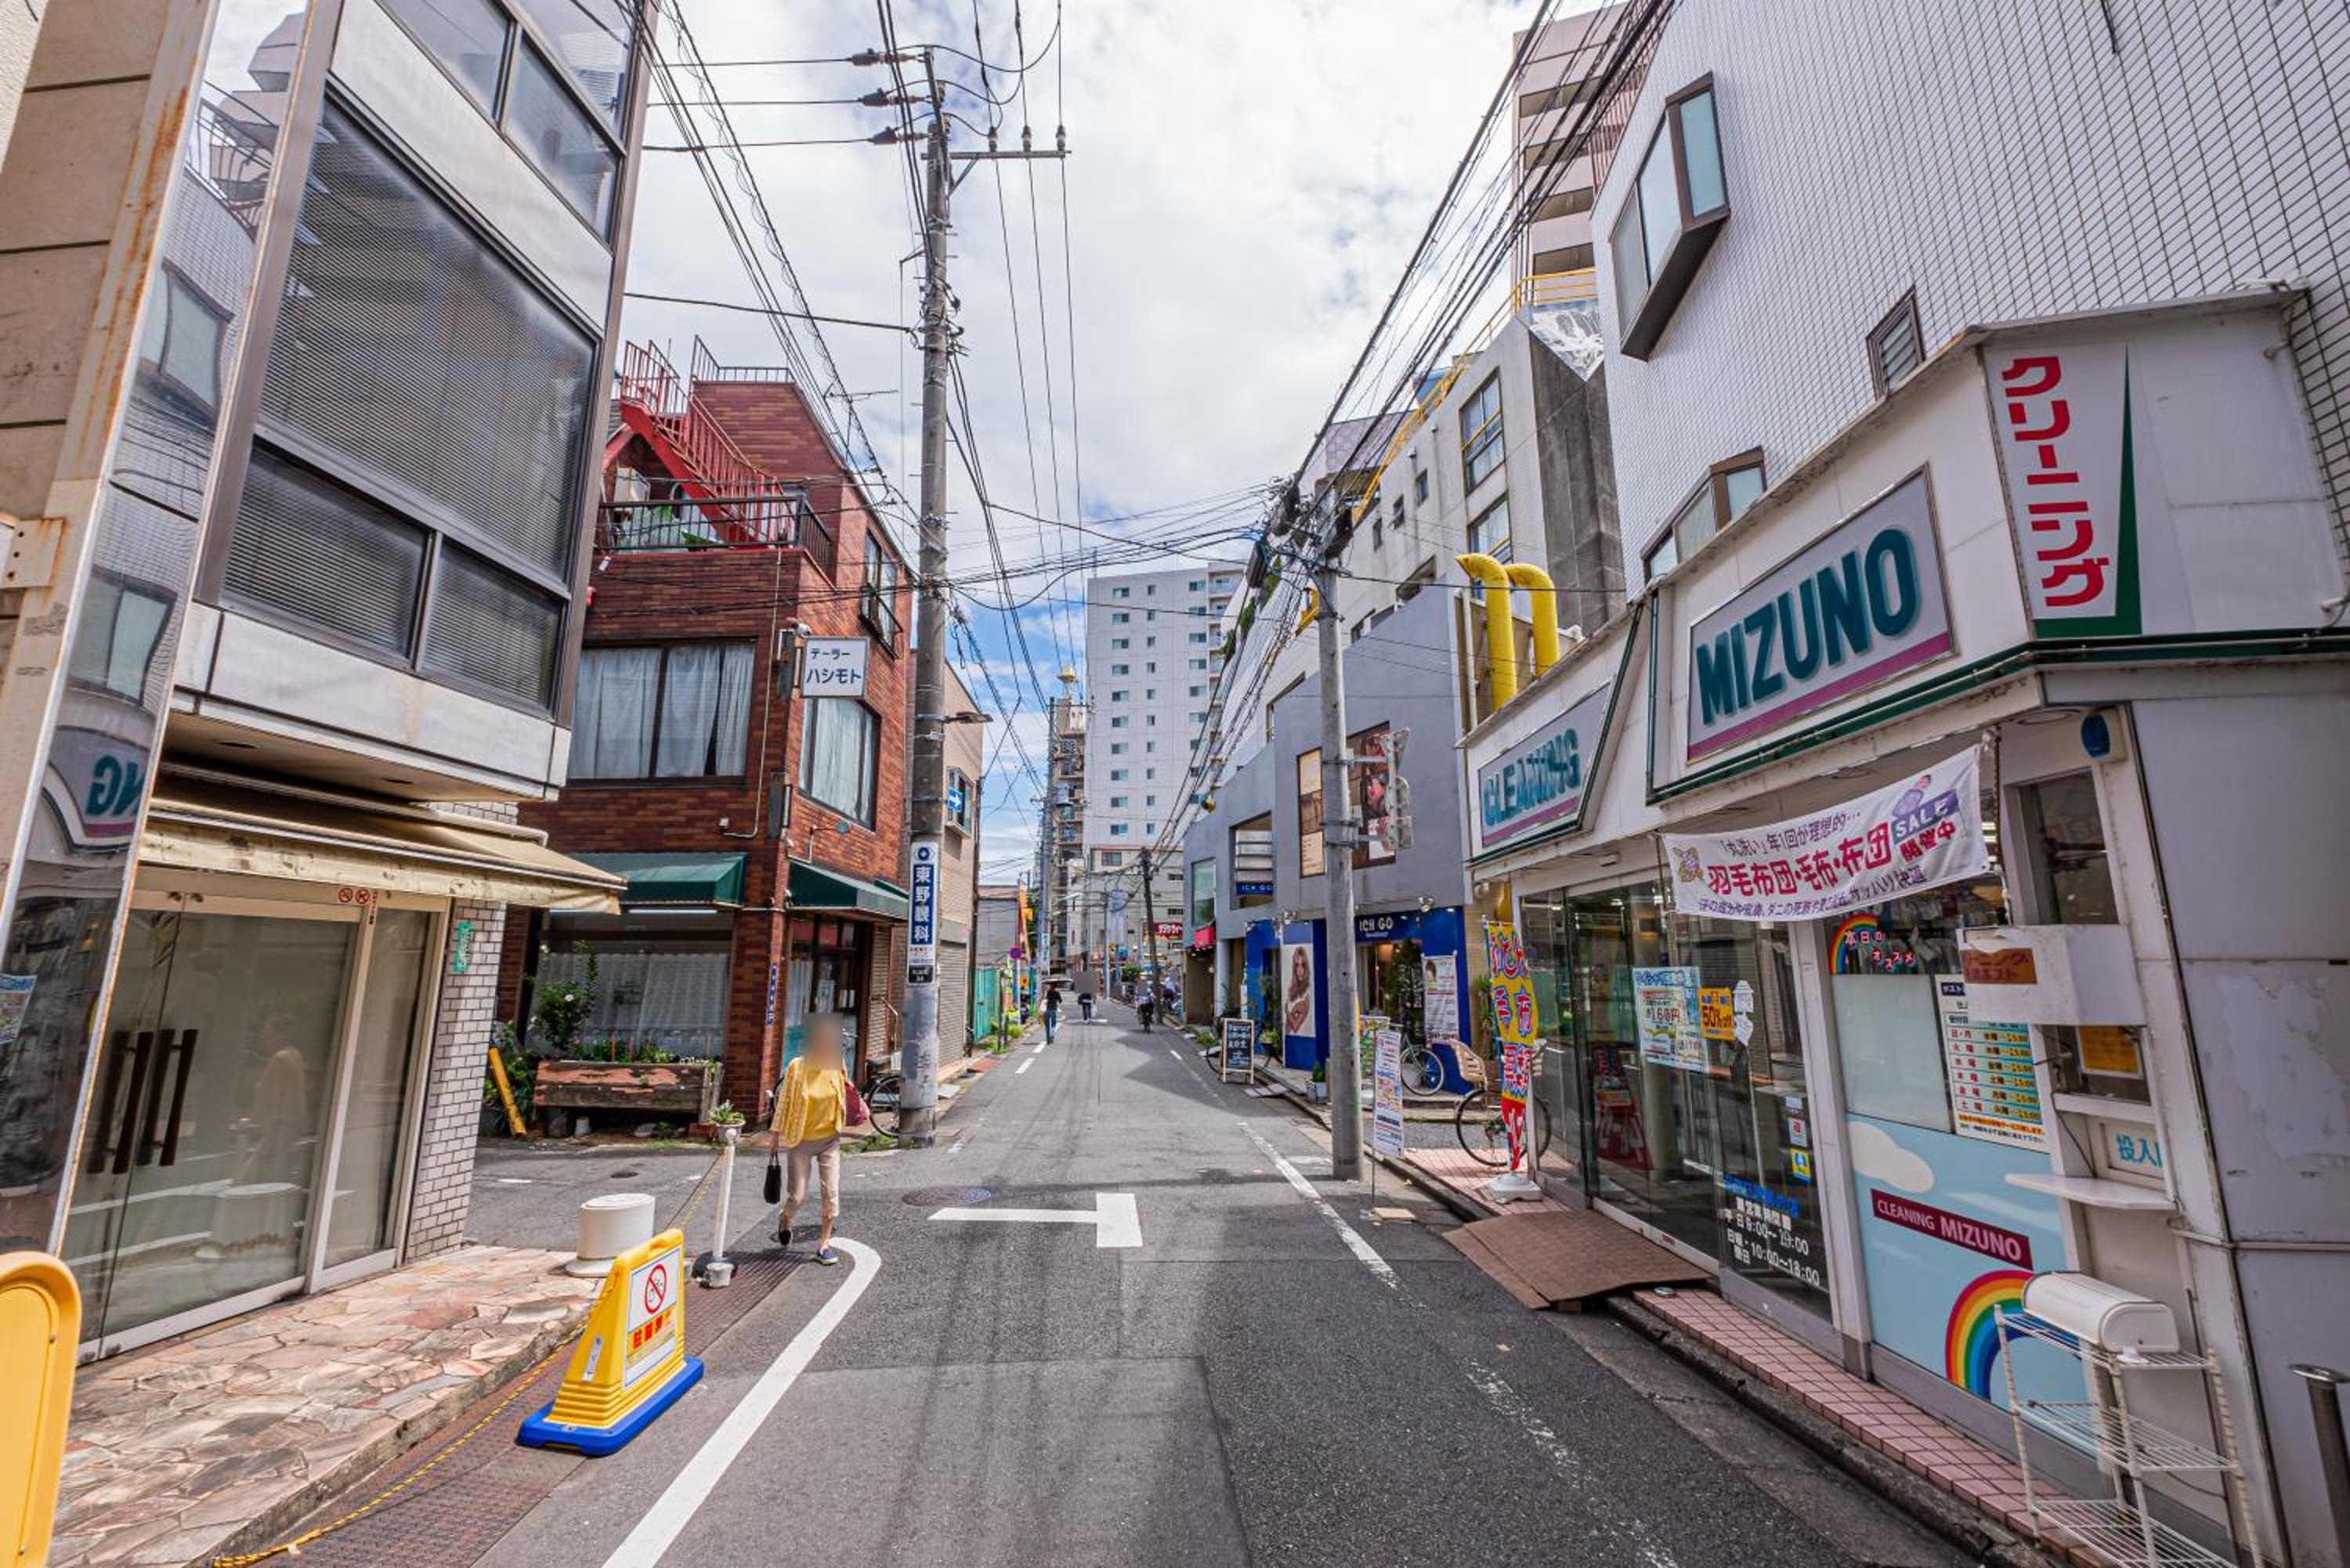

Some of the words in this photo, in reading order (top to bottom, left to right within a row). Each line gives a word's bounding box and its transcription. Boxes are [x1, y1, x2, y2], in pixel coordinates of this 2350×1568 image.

[2001, 355, 2110, 608] クリーニング
[1694, 527, 1923, 726] MIZUNO
[810, 648, 851, 660] テーラー
[806, 667, 862, 685] ハシモト
[1482, 728, 1581, 827] CLEANING
[1894, 796, 1949, 838] SALE
[1899, 821, 1957, 863] 開催中
[1378, 916, 1394, 930] GO
[1876, 1198, 1935, 1231] CLEANING
[1940, 1216, 2023, 1263] MIZUNO
